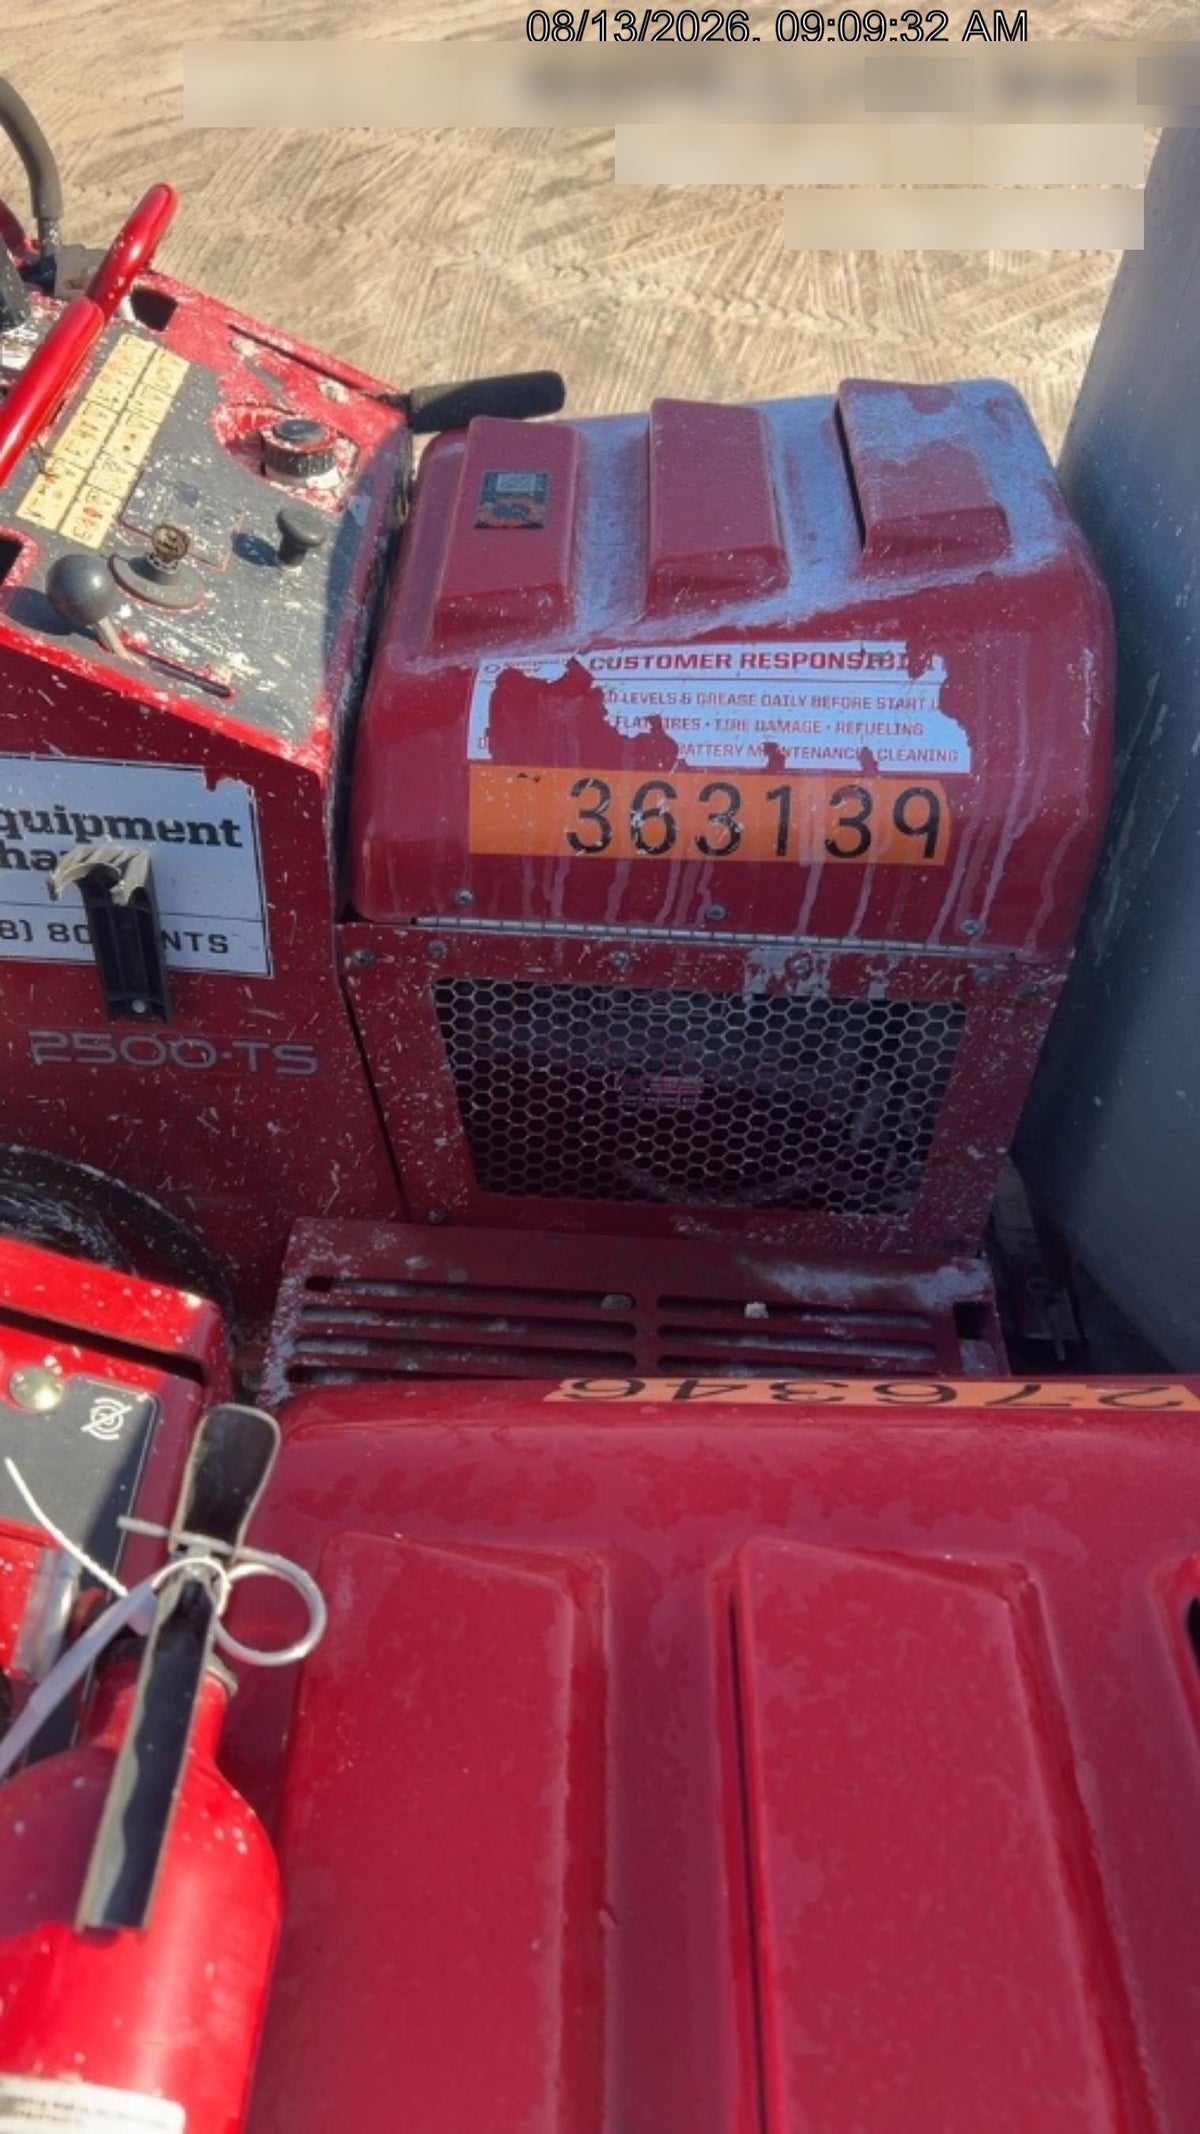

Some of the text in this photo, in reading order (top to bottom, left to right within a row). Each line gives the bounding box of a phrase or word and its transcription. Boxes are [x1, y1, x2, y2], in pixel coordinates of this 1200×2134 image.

[589, 651, 934, 671] CUSTOMER RESPONSIBI
[621, 691, 678, 705] LEVELS
[682, 692, 692, 705] &
[696, 692, 757, 708] GREASE
[761, 693, 808, 708] DAILY
[810, 694, 872, 710] BEFORE
[876, 696, 926, 711] START
[664, 716, 701, 730] IRES
[714, 717, 749, 732] TIRE
[755, 719, 822, 734] DAMAGE
[835, 721, 924, 736] REFUELING
[677, 743, 959, 762] BATTERY MNTENANC CLEANING
[0, 804, 242, 848] quipment
[564, 776, 942, 858] 363139
[0, 919, 33, 943] 8)
[563, 1378, 1185, 1409] 276346
